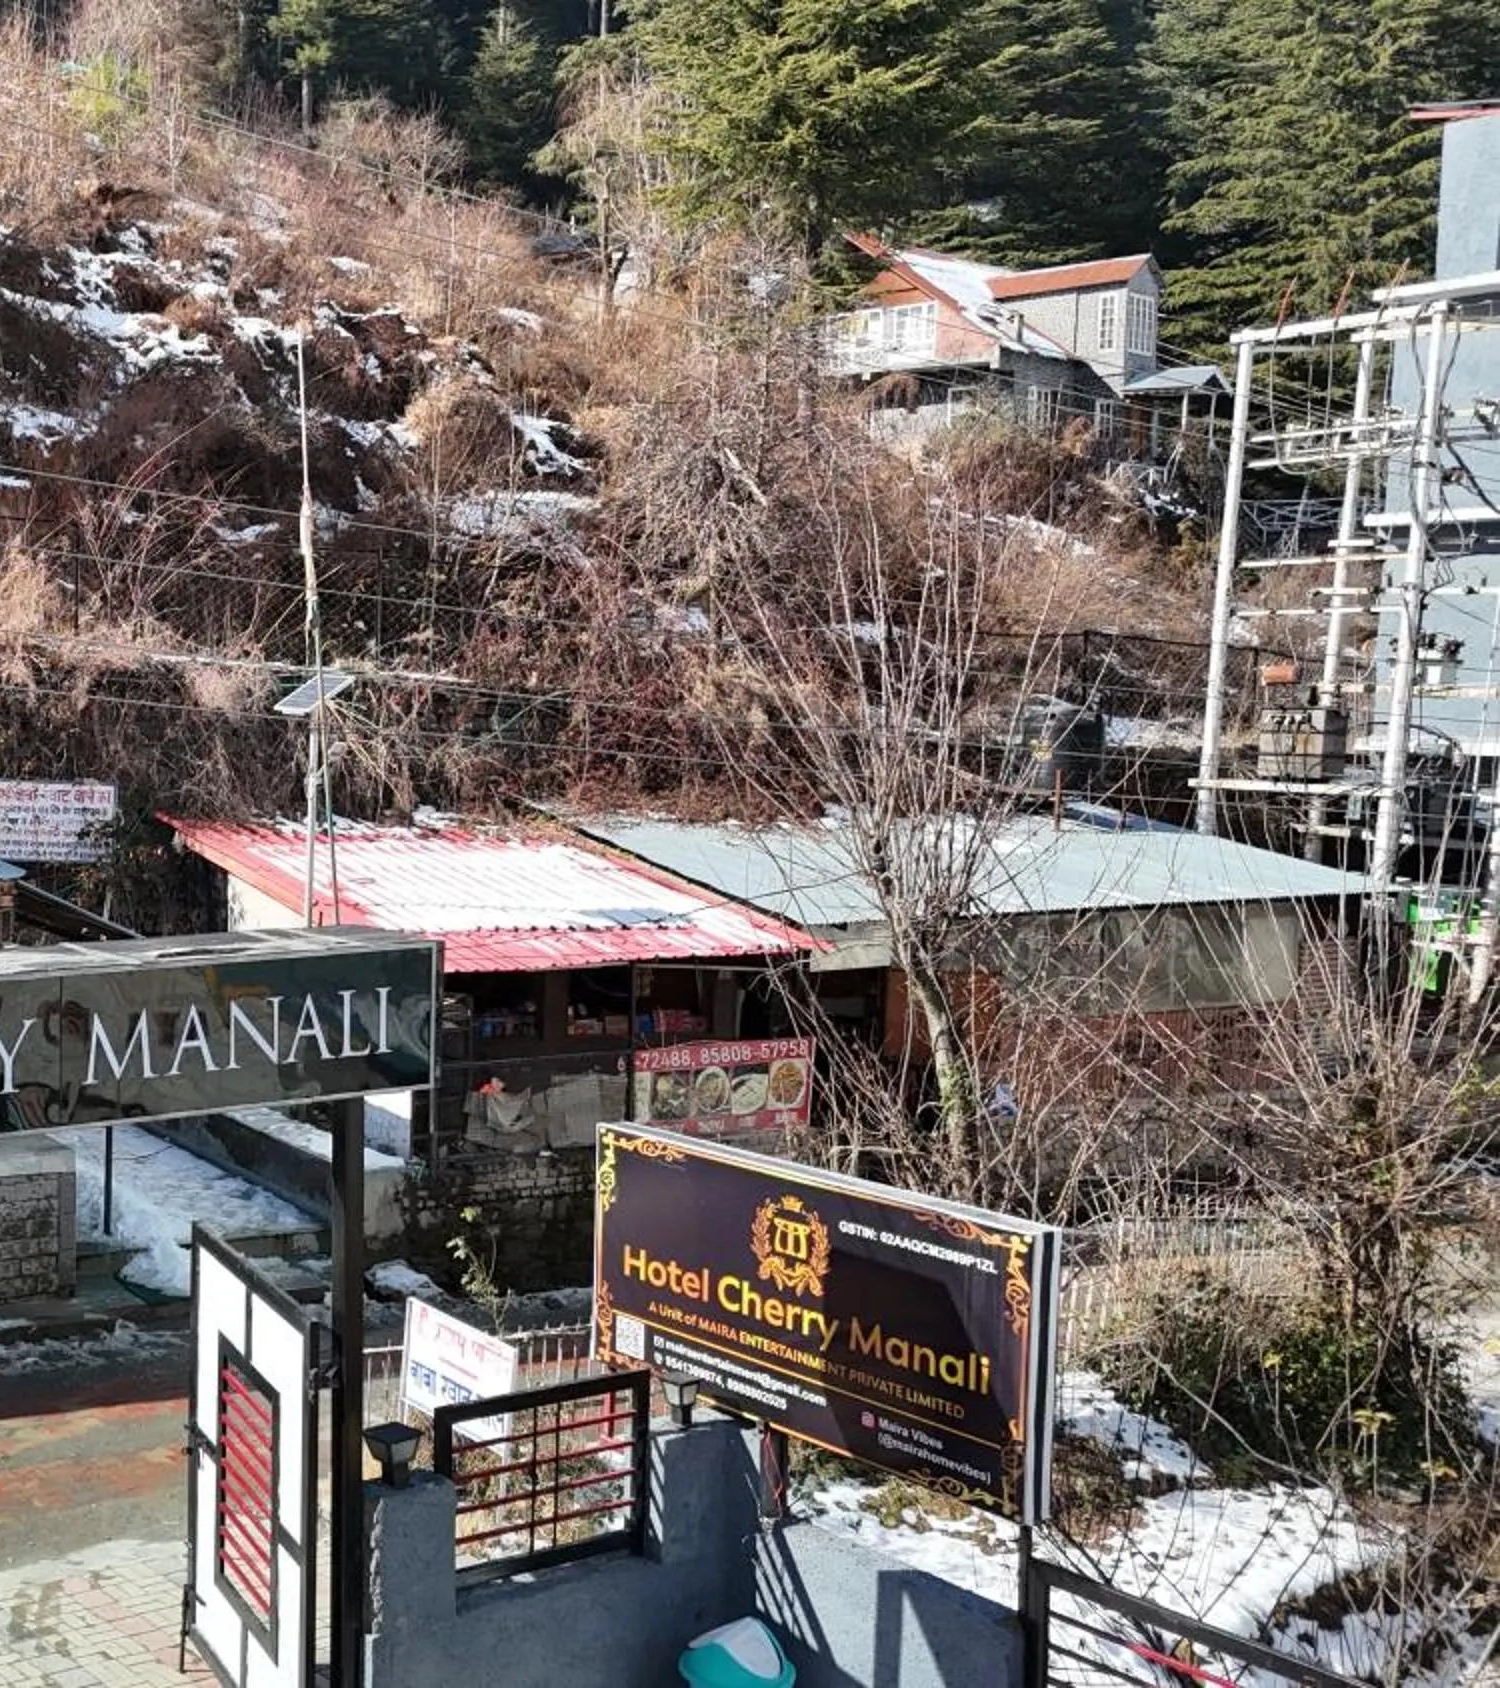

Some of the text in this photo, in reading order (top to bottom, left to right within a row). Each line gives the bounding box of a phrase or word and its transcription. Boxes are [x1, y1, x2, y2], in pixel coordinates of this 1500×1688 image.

[82, 986, 393, 1086] MANALI
[837, 1219, 878, 1242] GSTIN:
[622, 1243, 991, 1395] Hotel Cherry Manali
[648, 1301, 965, 1420] A Unit of MAIRA ENTERTAINMENT PRIVATE LIMITED
[877, 1416, 944, 1450] Maira Vibes
